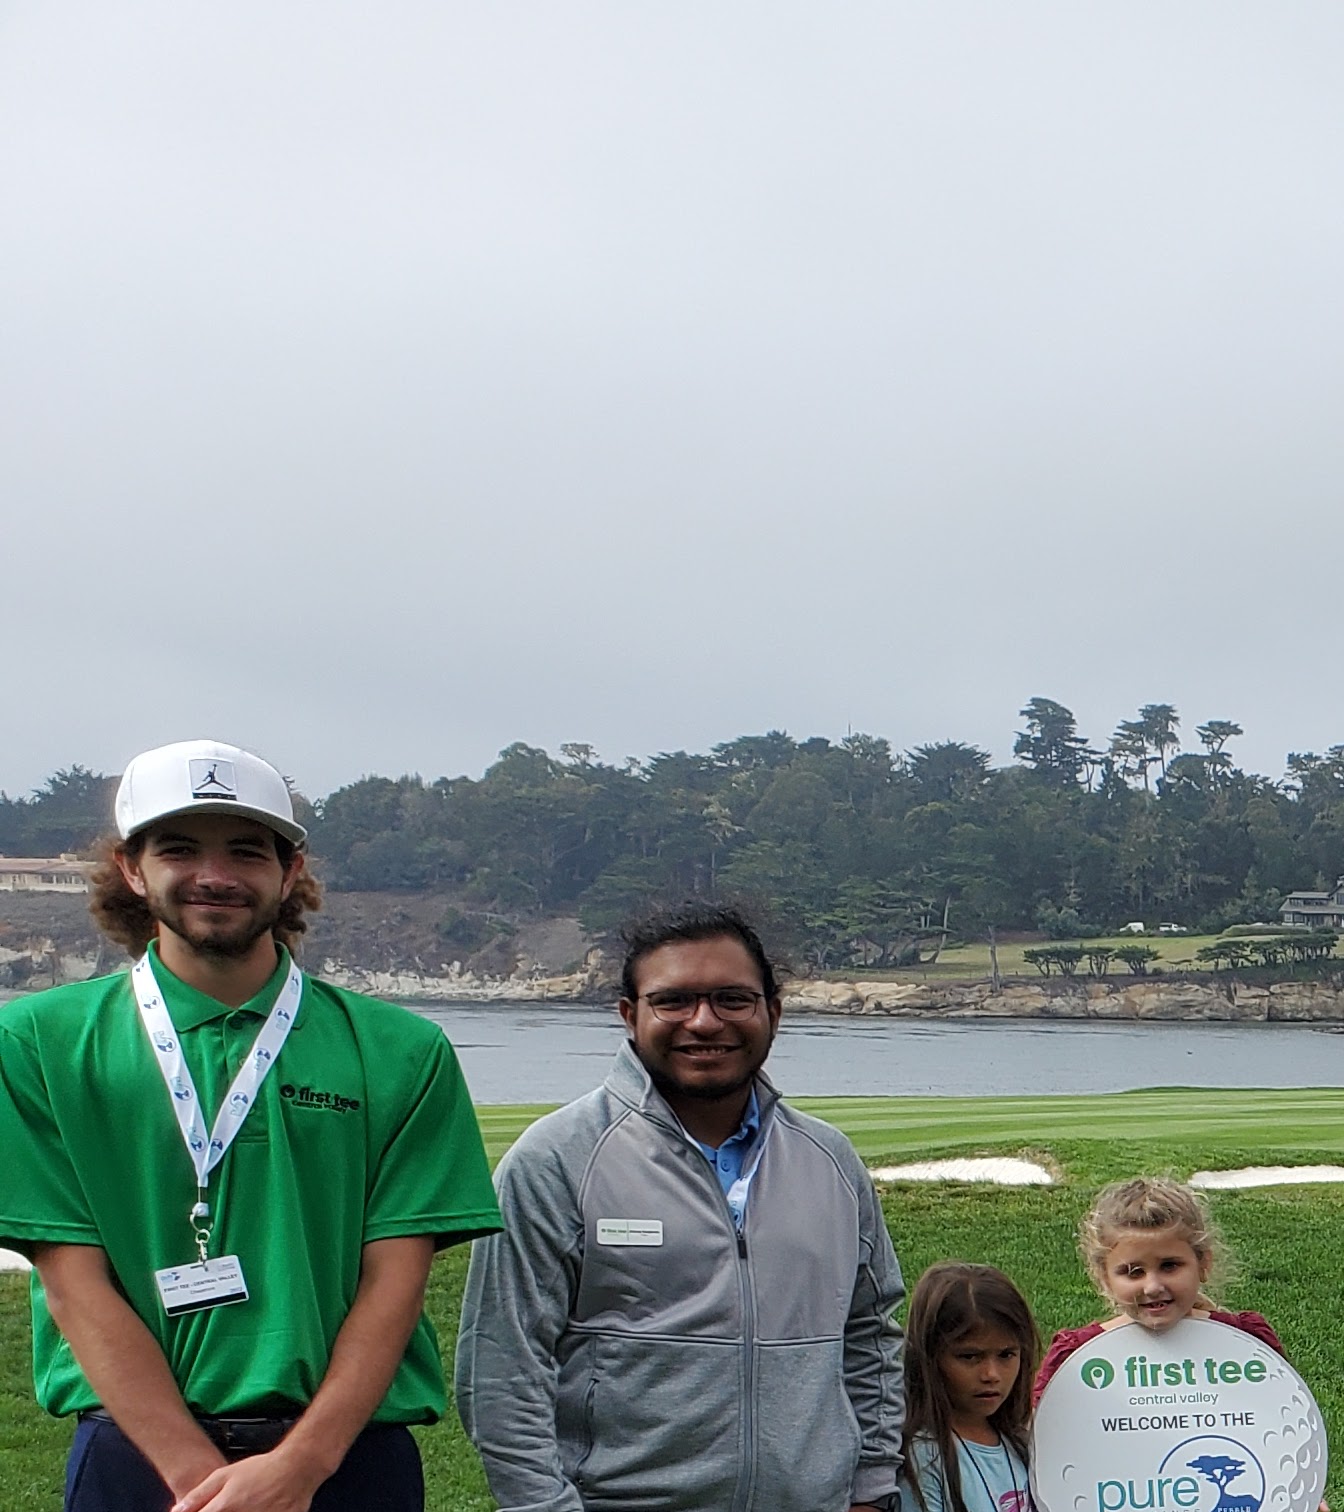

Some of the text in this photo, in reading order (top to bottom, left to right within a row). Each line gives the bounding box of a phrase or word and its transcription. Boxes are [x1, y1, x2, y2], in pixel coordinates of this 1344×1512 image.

[299, 1087, 359, 1110] first tee
[1125, 1356, 1267, 1387] first tee
[1129, 1392, 1219, 1405] central valley
[1101, 1412, 1255, 1432] WELCOME TO THE
